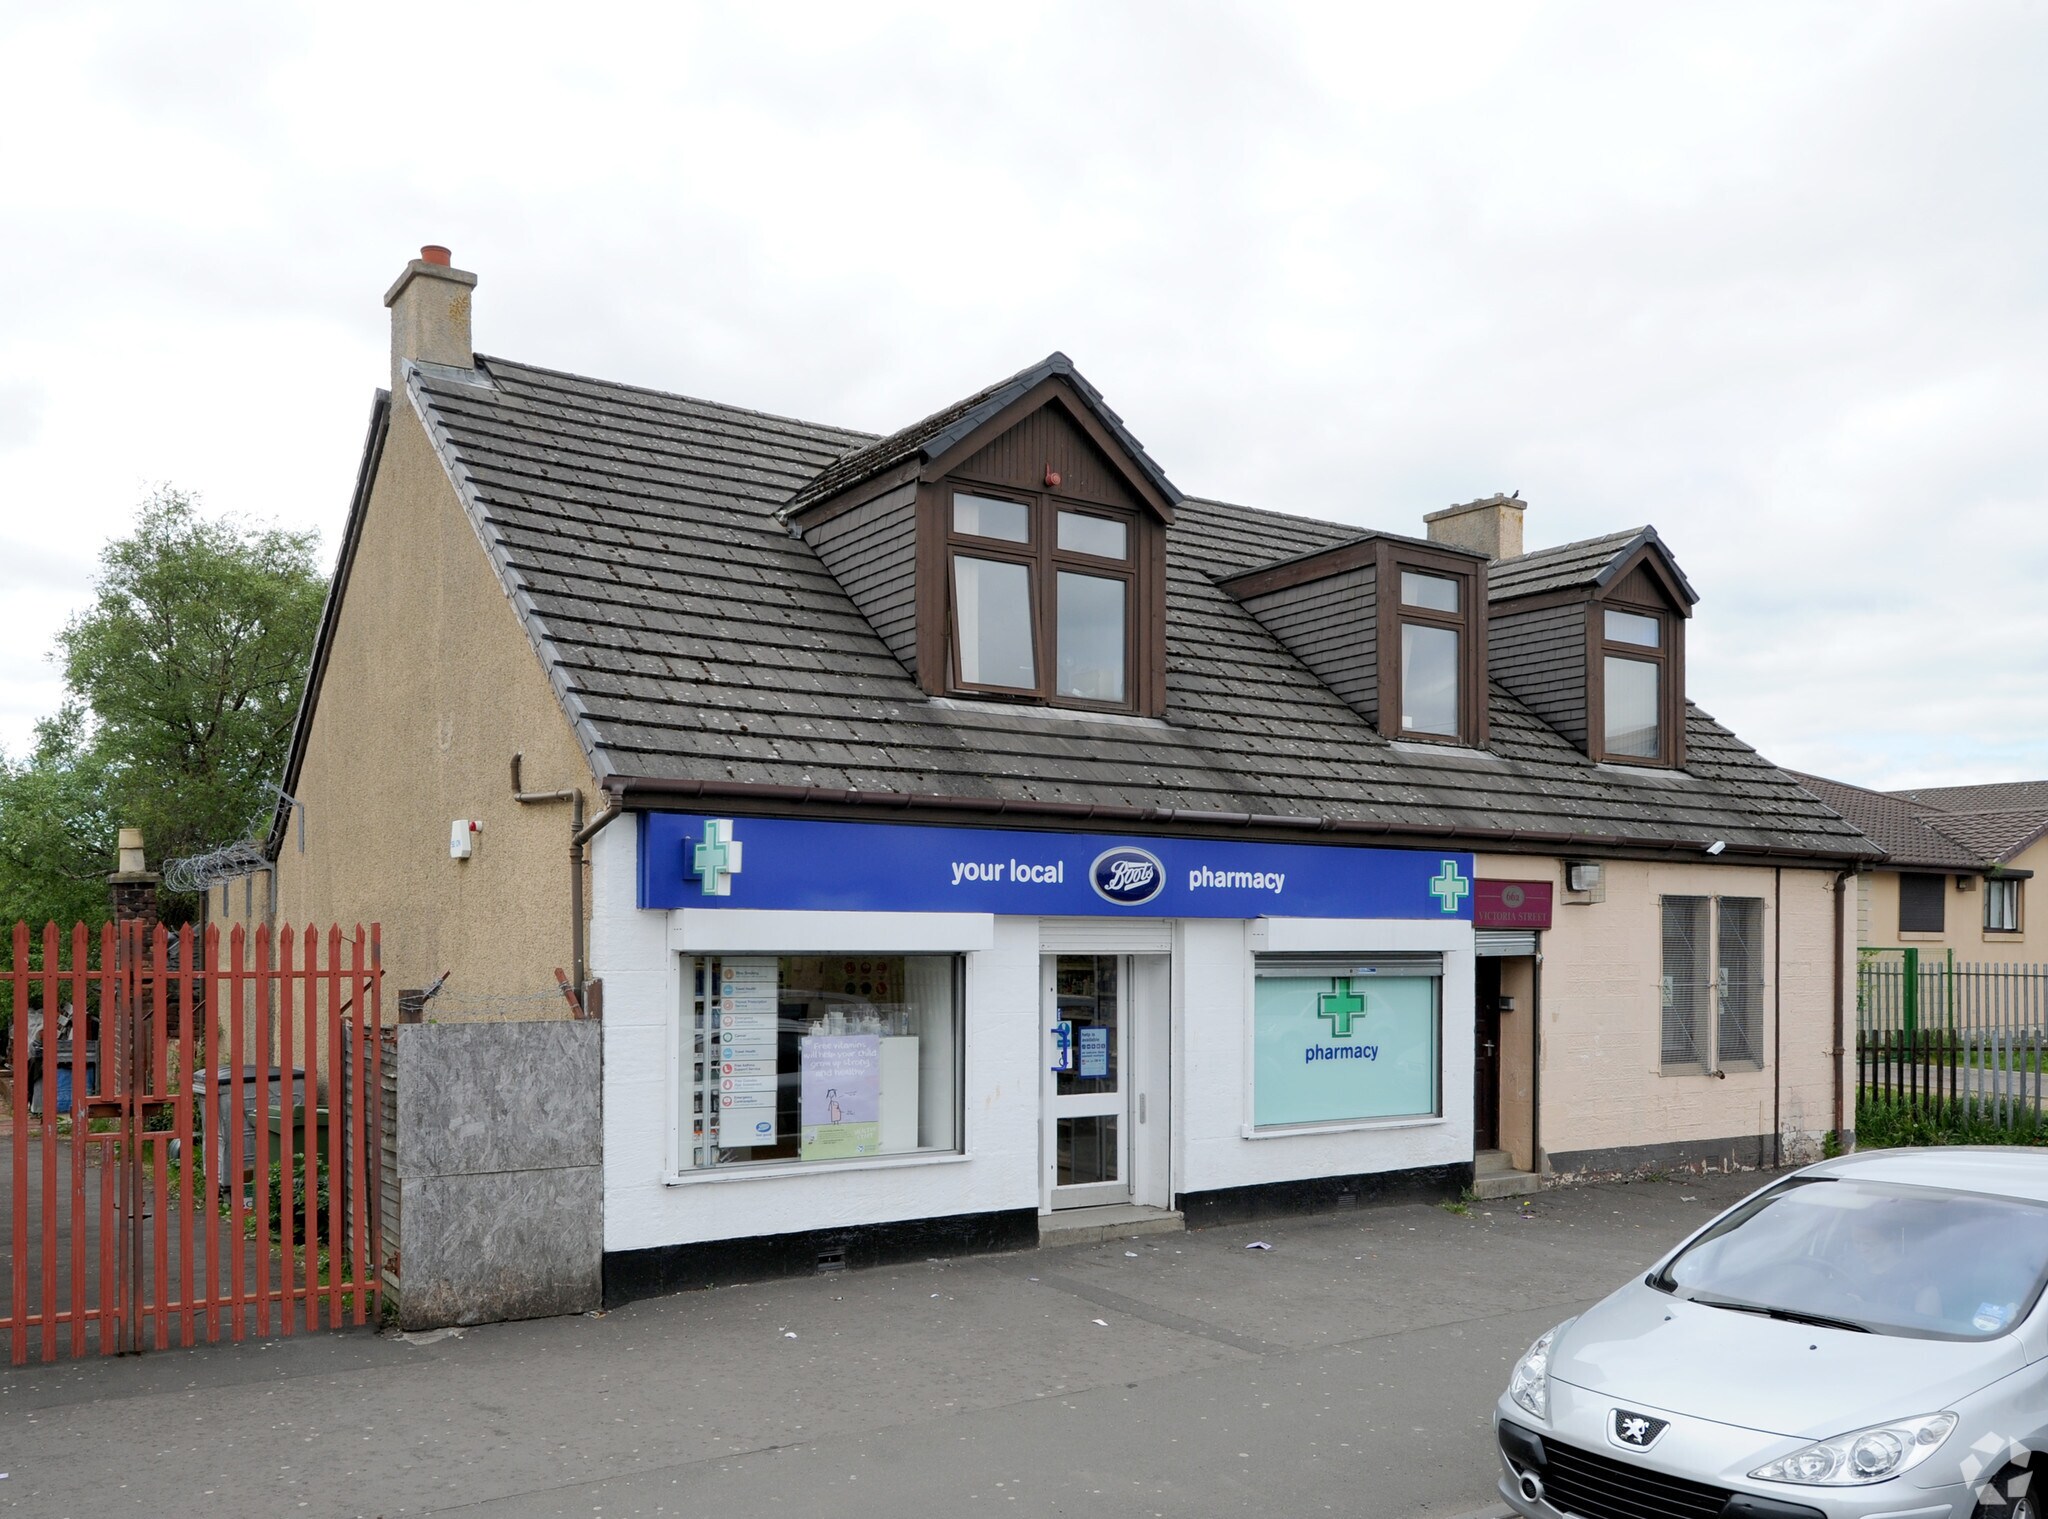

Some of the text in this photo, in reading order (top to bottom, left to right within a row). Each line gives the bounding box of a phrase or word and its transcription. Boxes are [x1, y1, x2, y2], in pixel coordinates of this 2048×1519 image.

[951, 858, 1064, 886] your local
[1104, 860, 1153, 892] Boots
[1189, 865, 1285, 894] pharmacy
[1478, 911, 1547, 922] VICTORIA STREET
[813, 1042, 832, 1051] Free
[1305, 1044, 1379, 1065] pharmacy
